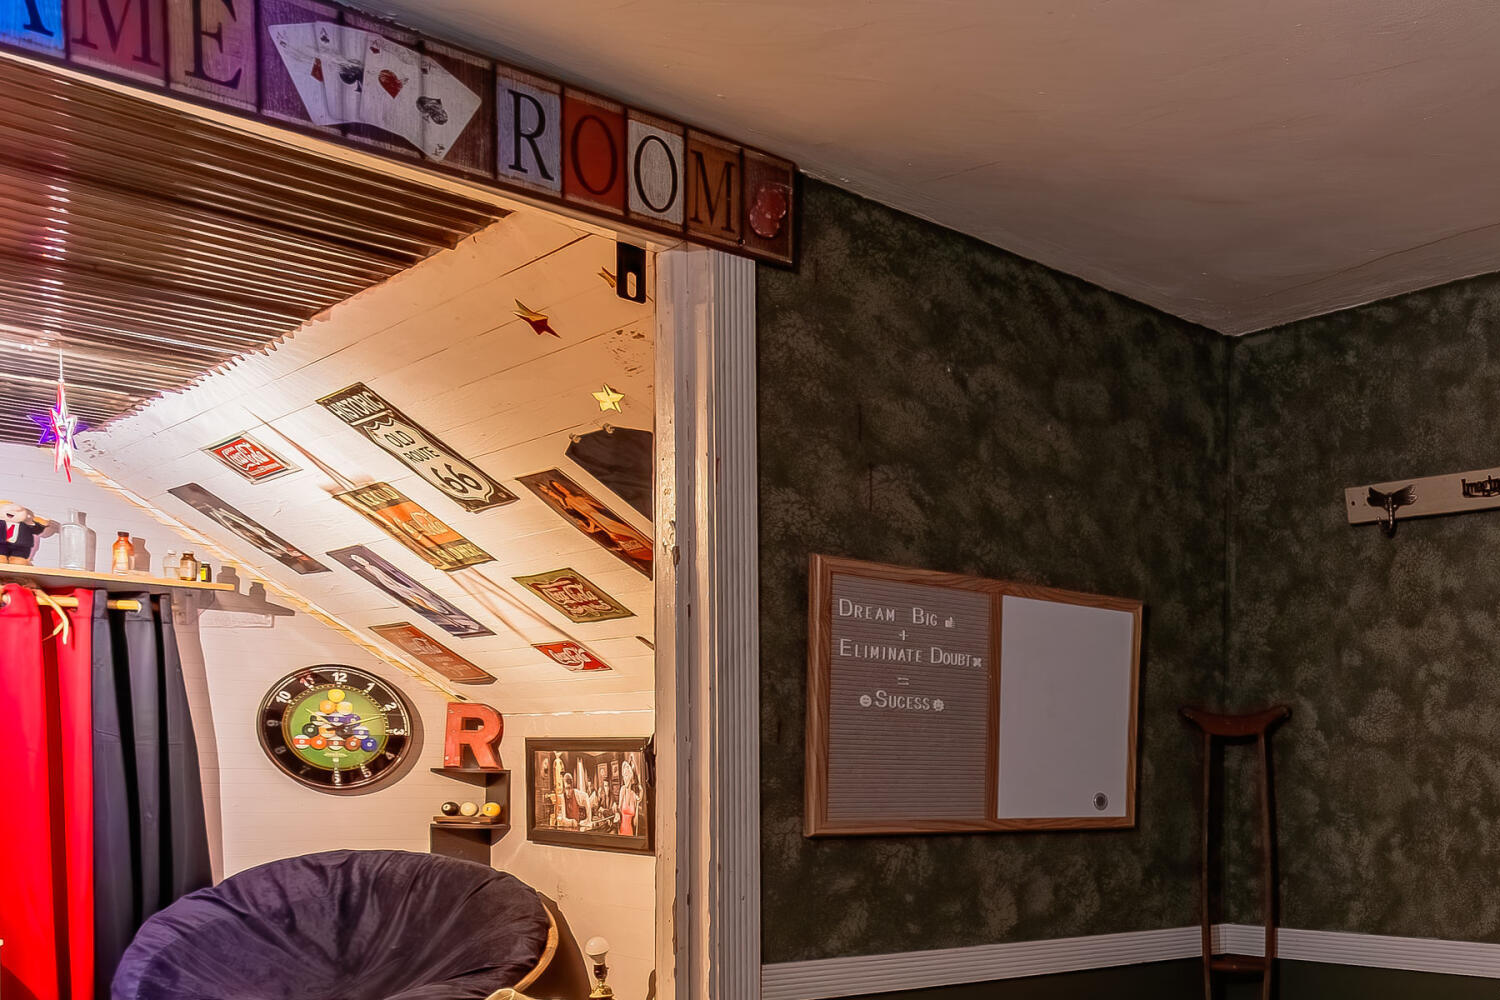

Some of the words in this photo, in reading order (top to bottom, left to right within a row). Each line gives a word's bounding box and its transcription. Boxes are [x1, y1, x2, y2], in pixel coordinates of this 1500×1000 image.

[507, 89, 736, 234] ROOM
[327, 391, 386, 422] HISTORIC
[384, 430, 415, 448] OLD
[403, 446, 440, 463] ROUTE
[430, 463, 483, 495] 66
[332, 672, 348, 682] 12
[276, 690, 292, 703] 10
[443, 702, 503, 770] R
